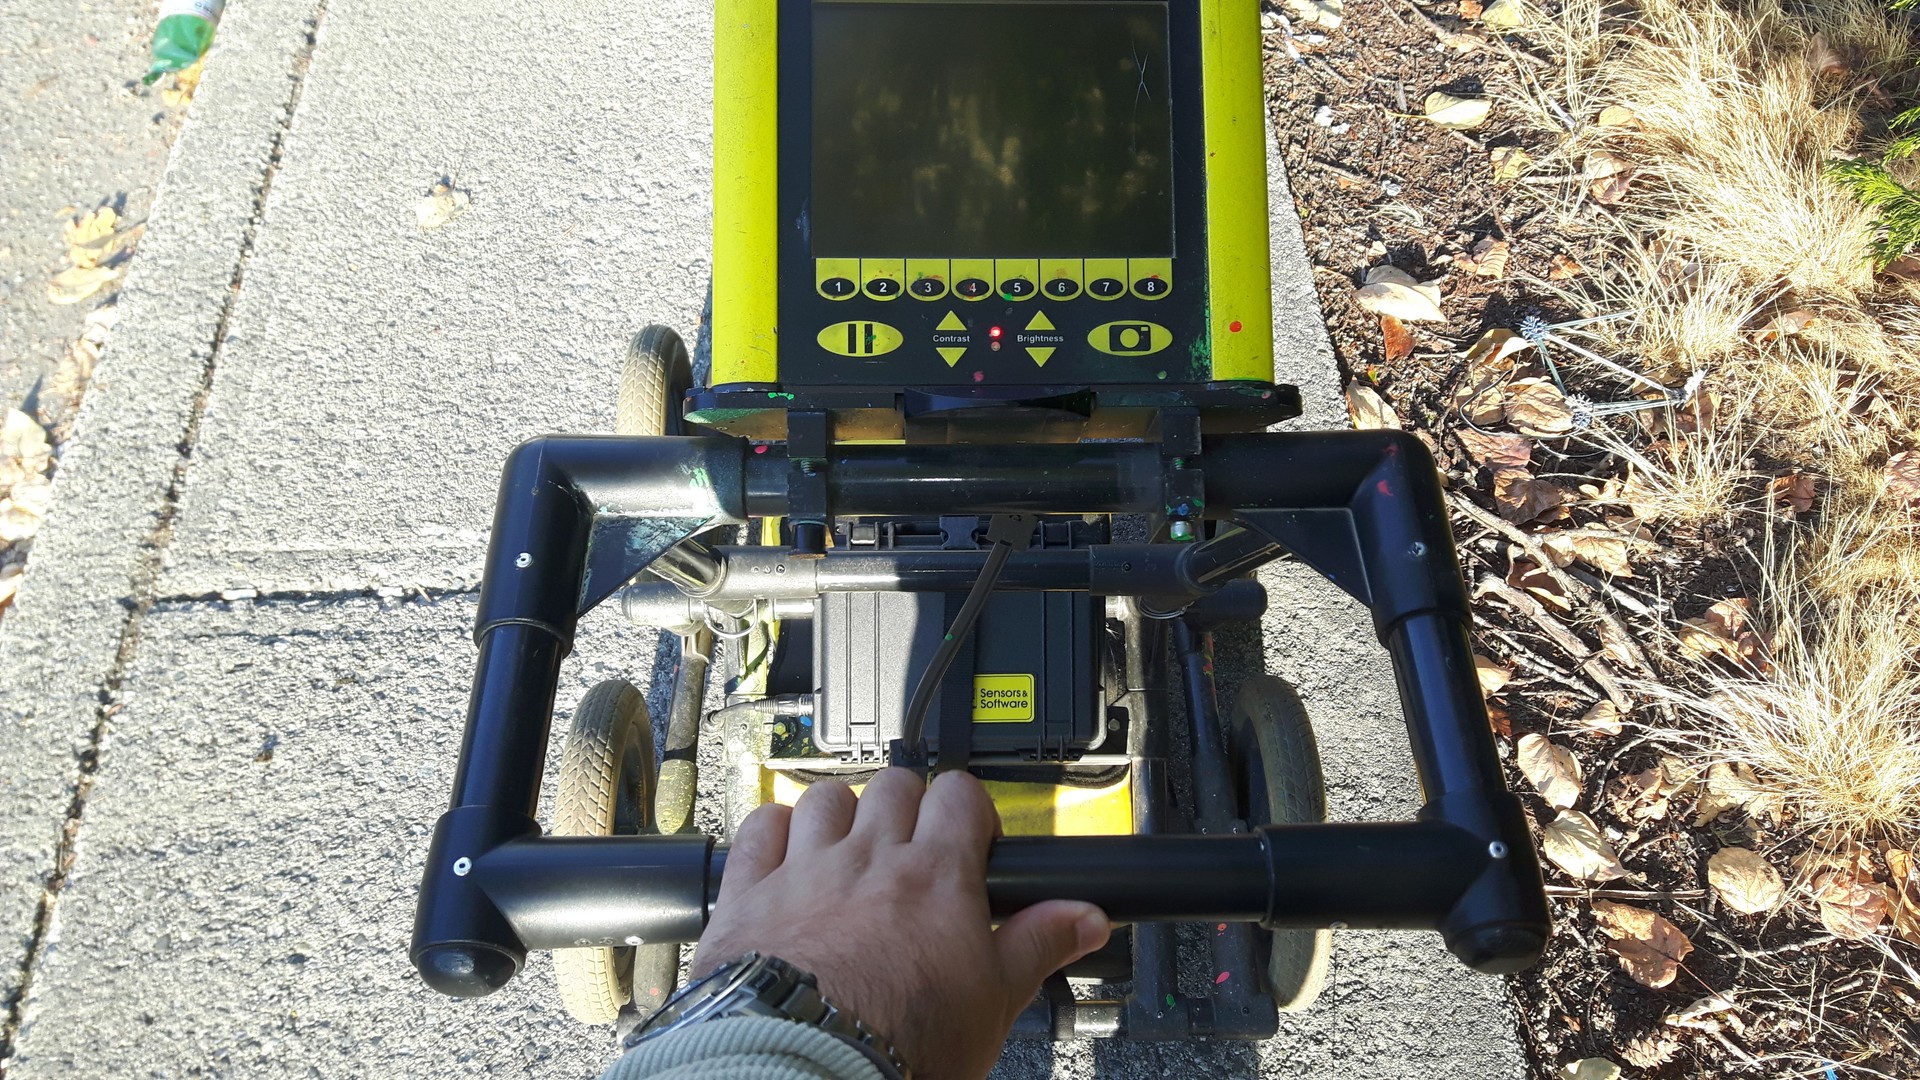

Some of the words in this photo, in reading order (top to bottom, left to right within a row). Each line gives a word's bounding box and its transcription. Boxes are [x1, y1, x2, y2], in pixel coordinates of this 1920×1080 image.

[835, 282, 841, 292] 1
[879, 282, 887, 293] 2
[924, 283, 932, 293] 3
[968, 283, 977, 293] 4
[1013, 282, 1021, 293] 5
[1058, 282, 1066, 293] 6
[1102, 282, 1110, 292] 7
[1147, 282, 1155, 292] 8
[932, 334, 970, 343] Contrast
[1017, 334, 1064, 344] Brightness
[980, 699, 1028, 709] Software
